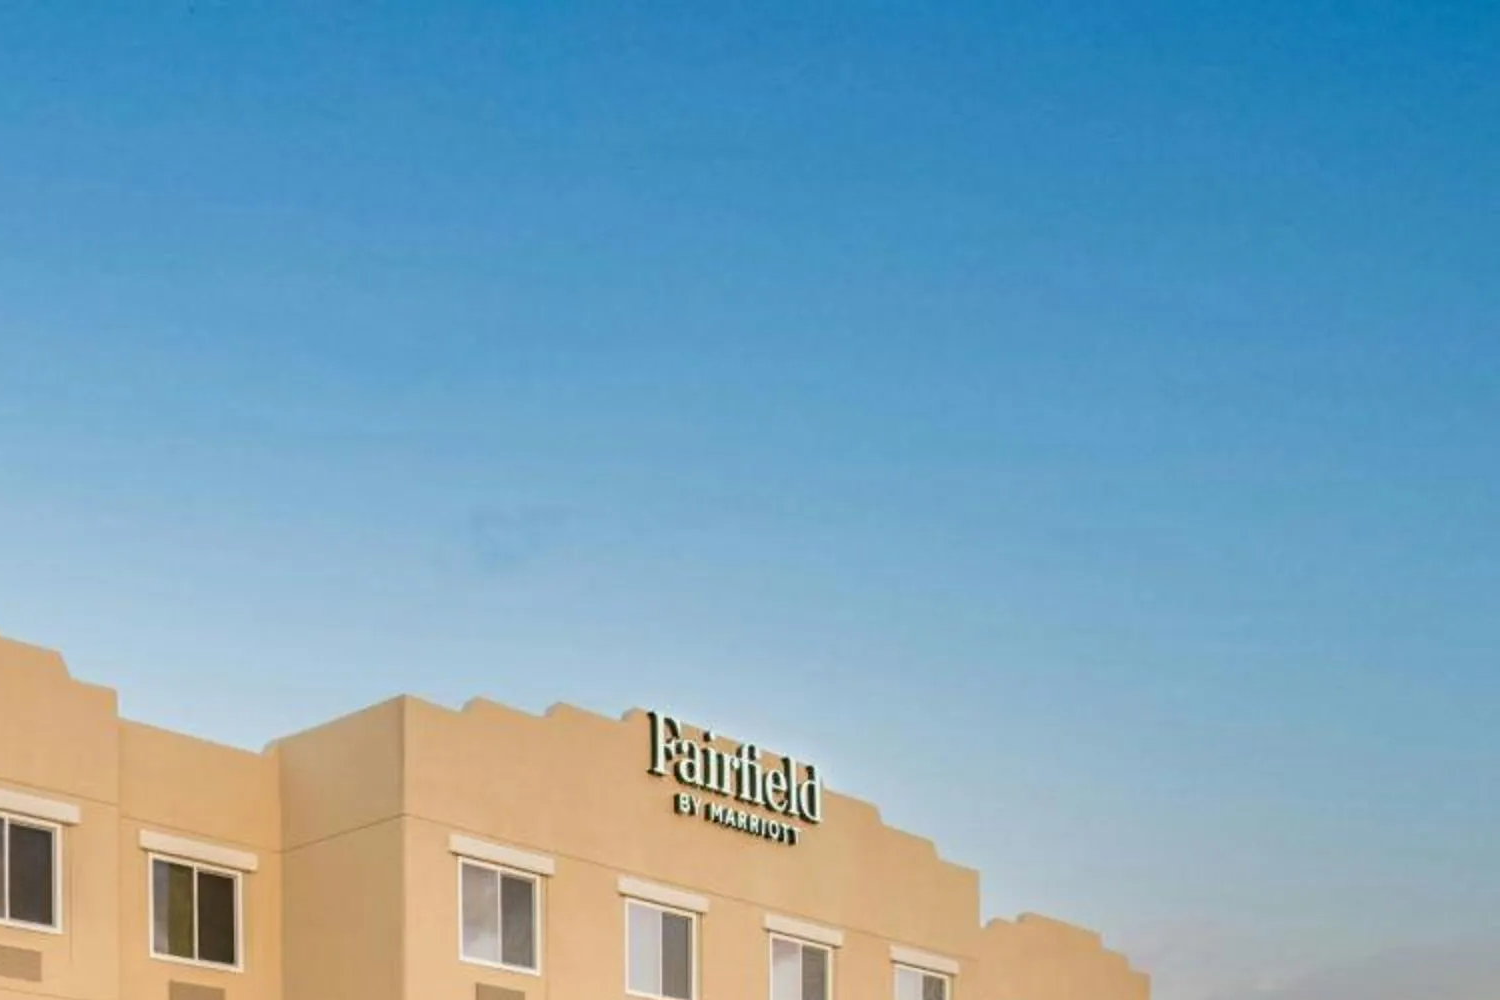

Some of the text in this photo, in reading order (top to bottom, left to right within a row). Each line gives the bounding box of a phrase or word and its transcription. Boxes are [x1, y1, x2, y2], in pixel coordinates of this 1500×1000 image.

[647, 711, 823, 824] Fairfield
[674, 793, 801, 845] BY MARRIOTT
